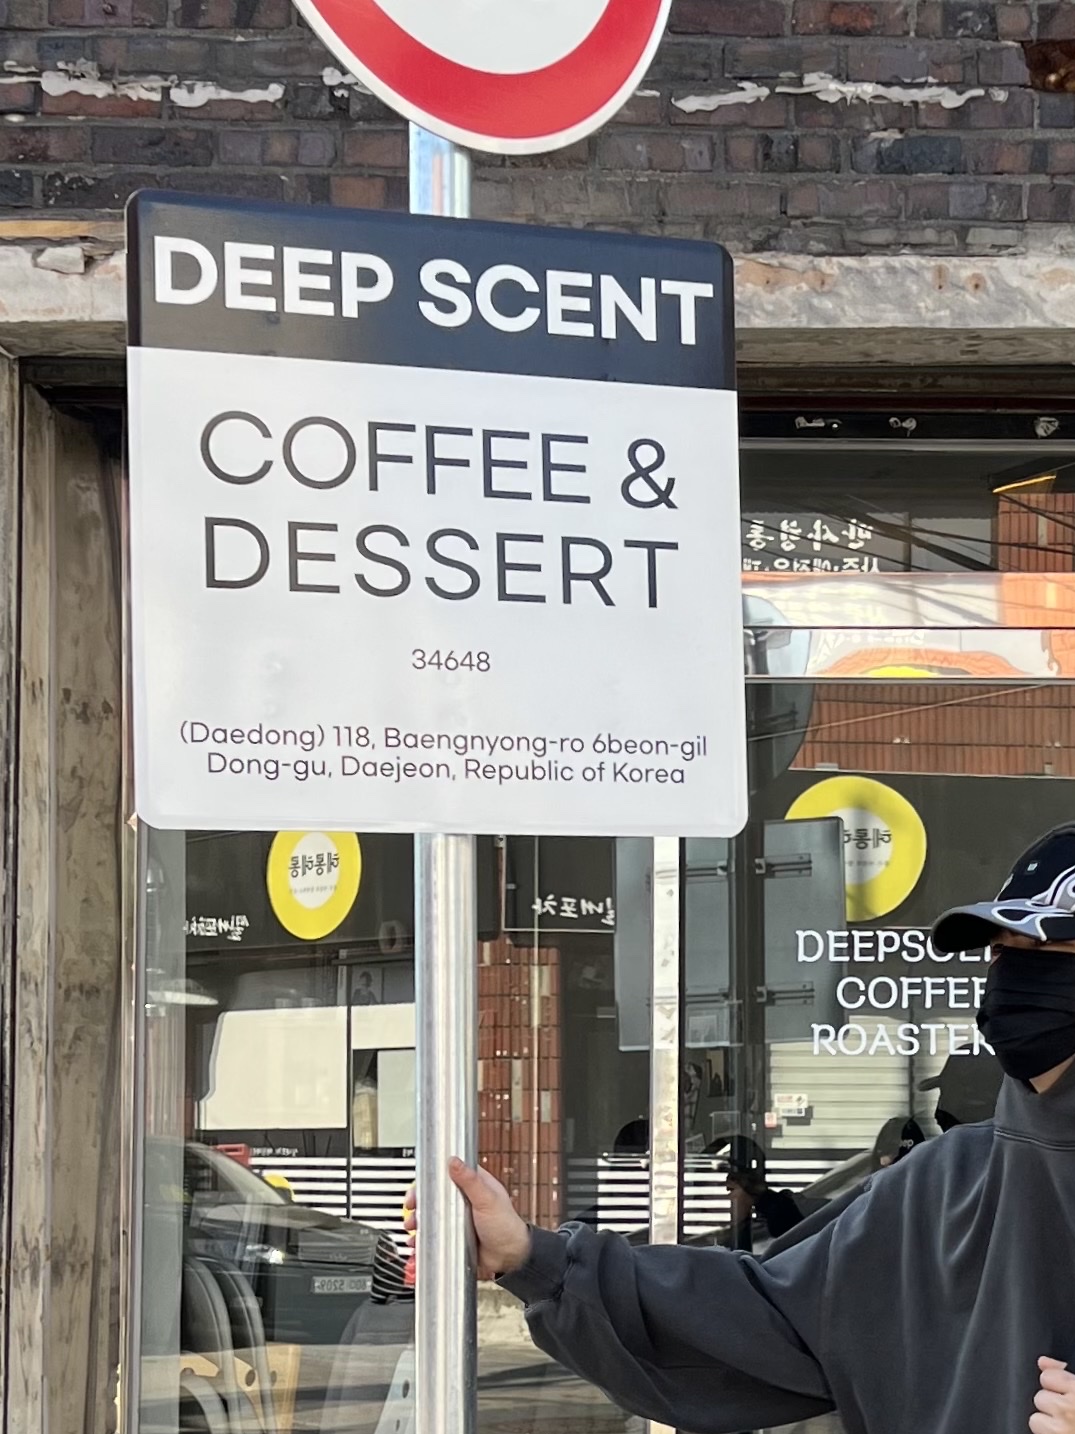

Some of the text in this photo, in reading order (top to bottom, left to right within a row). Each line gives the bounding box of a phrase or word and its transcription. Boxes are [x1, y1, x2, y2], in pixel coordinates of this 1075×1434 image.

[153, 235, 714, 346] DEEP SCENT
[200, 410, 680, 510] COFFEE &
[203, 516, 679, 609] DESSERT
[410, 647, 492, 673] 34648
[180, 720, 707, 761] (Daedong) 118, Baengnyong-ro 6beon-gil
[207, 752, 685, 785] Dong-gu, Daejeon, Republic of Korea
[795, 929, 992, 963] DEEPS
[811, 1023, 996, 1056] ROASTER
